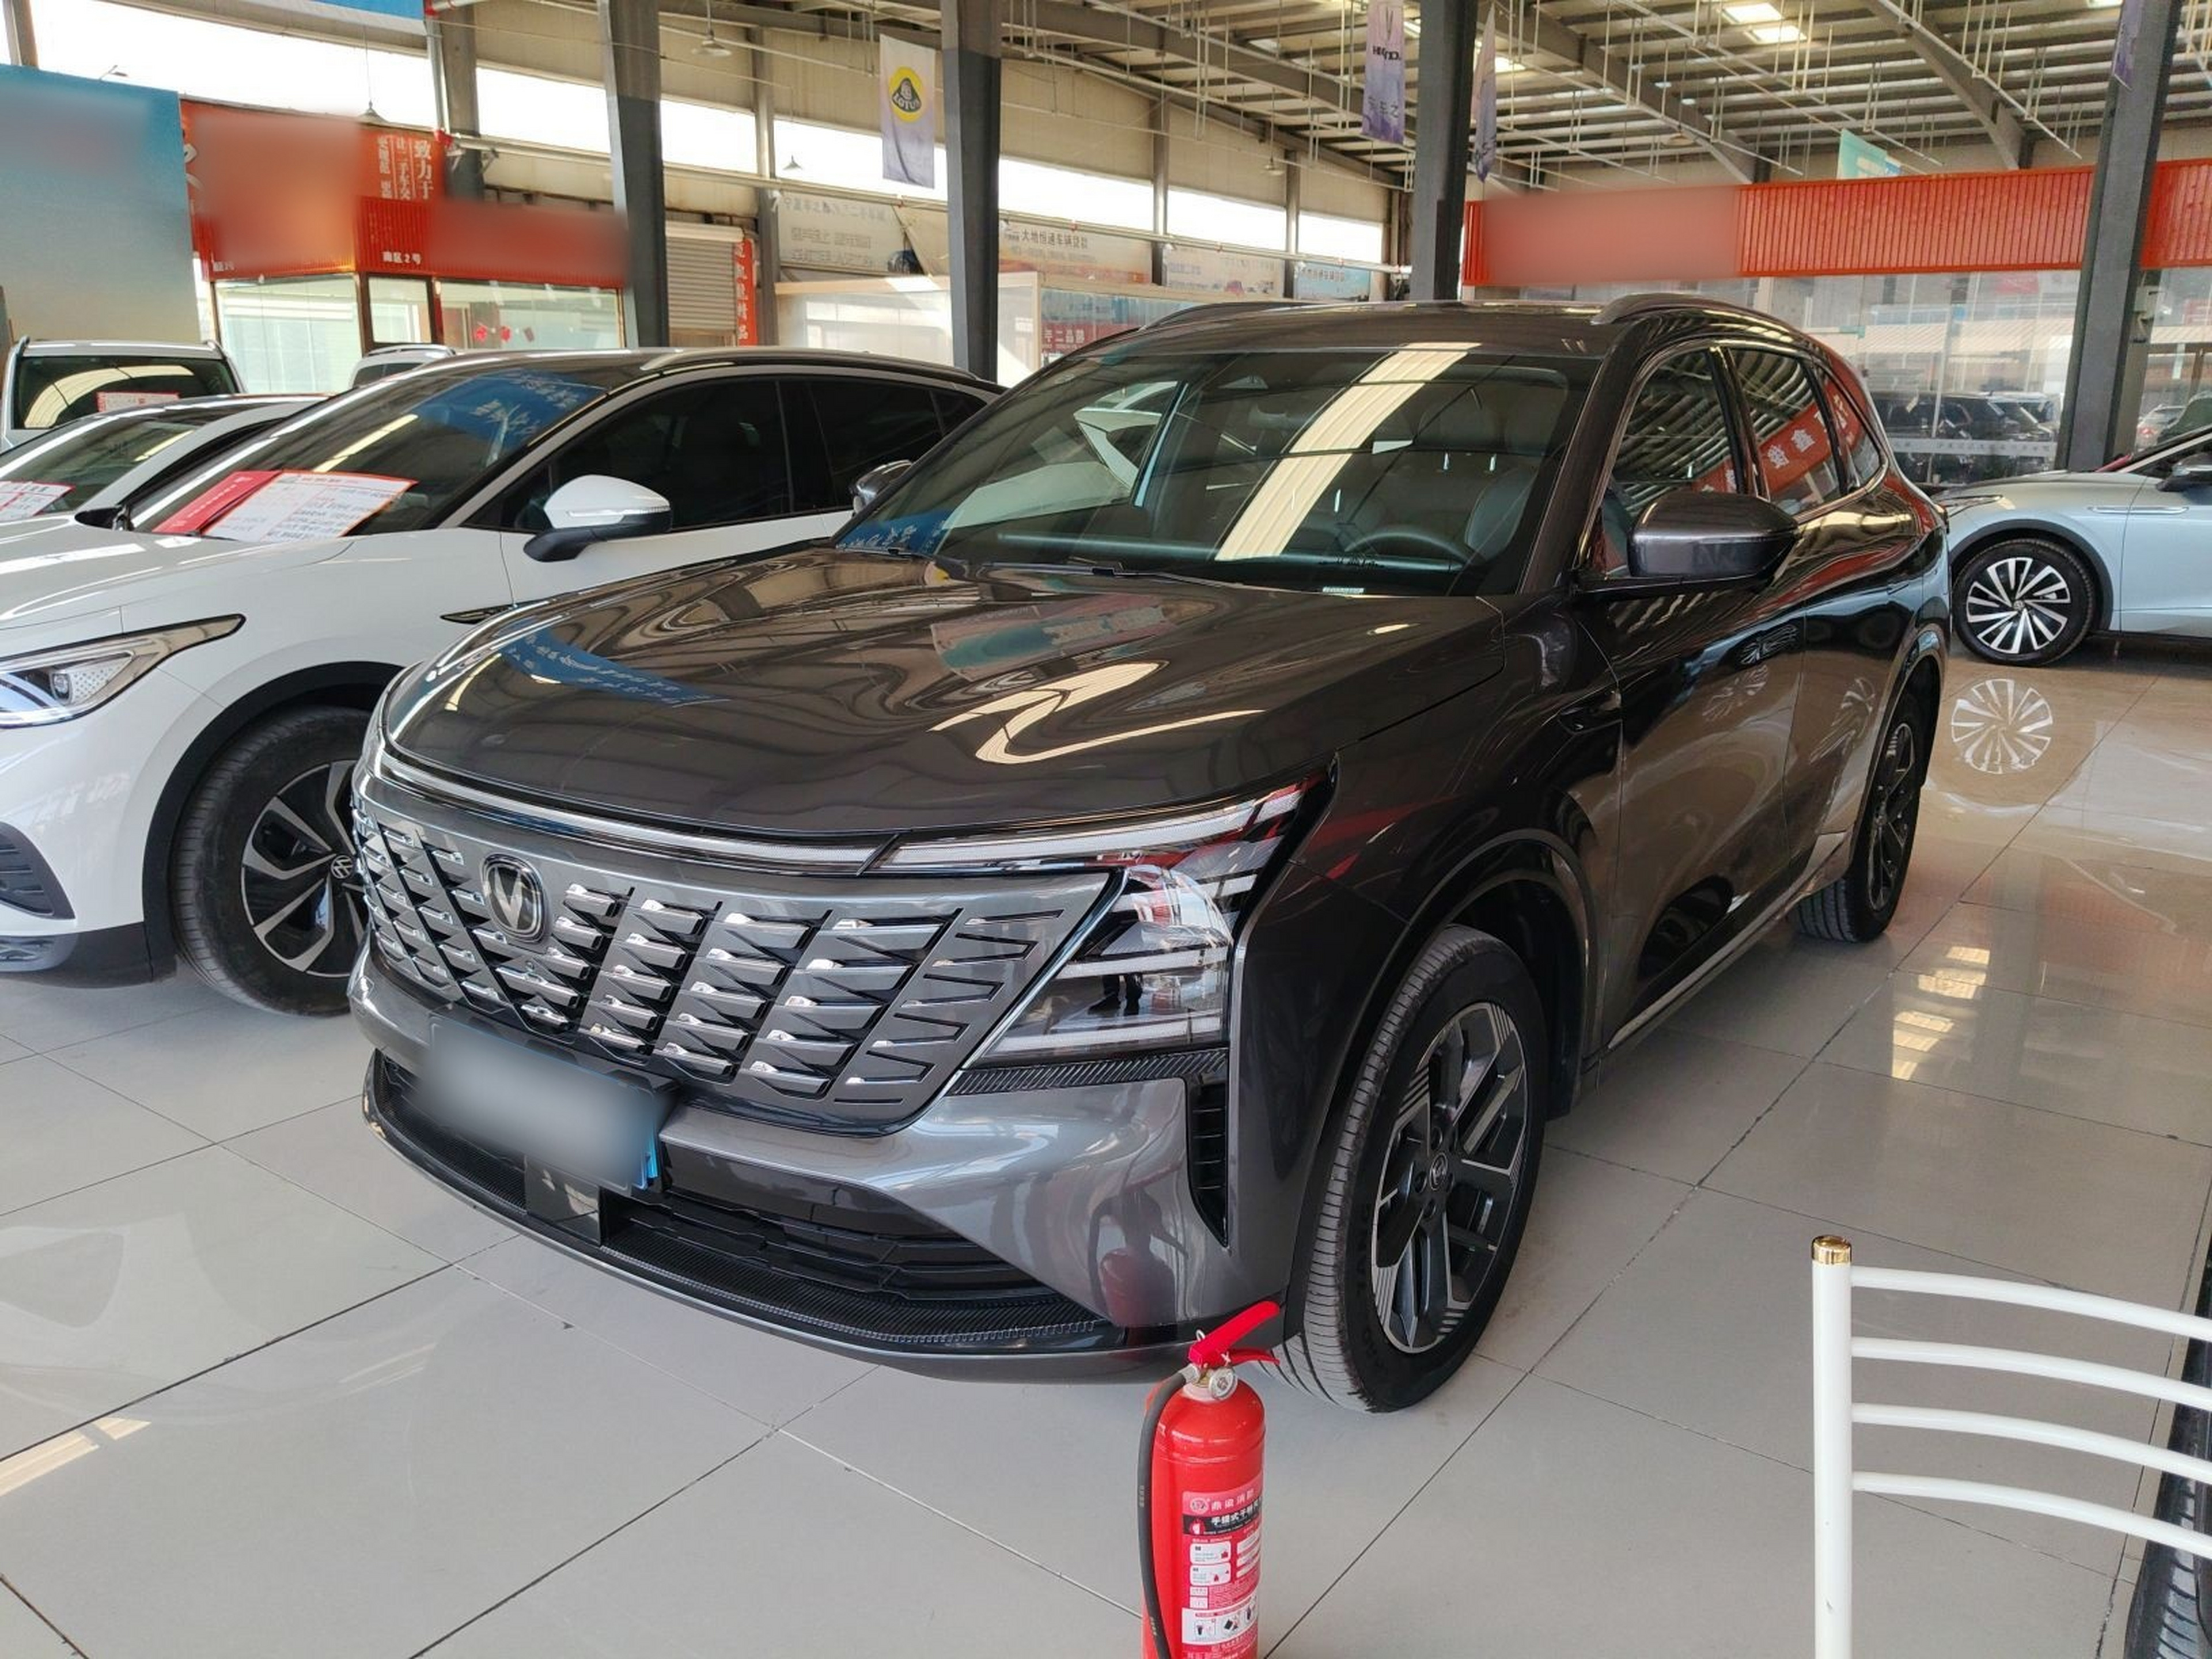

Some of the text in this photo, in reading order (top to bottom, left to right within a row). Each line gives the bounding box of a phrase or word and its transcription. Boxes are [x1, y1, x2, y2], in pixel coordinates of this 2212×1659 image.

[892, 92, 921, 110] LOTUS
[414, 140, 434, 200] 致力于
